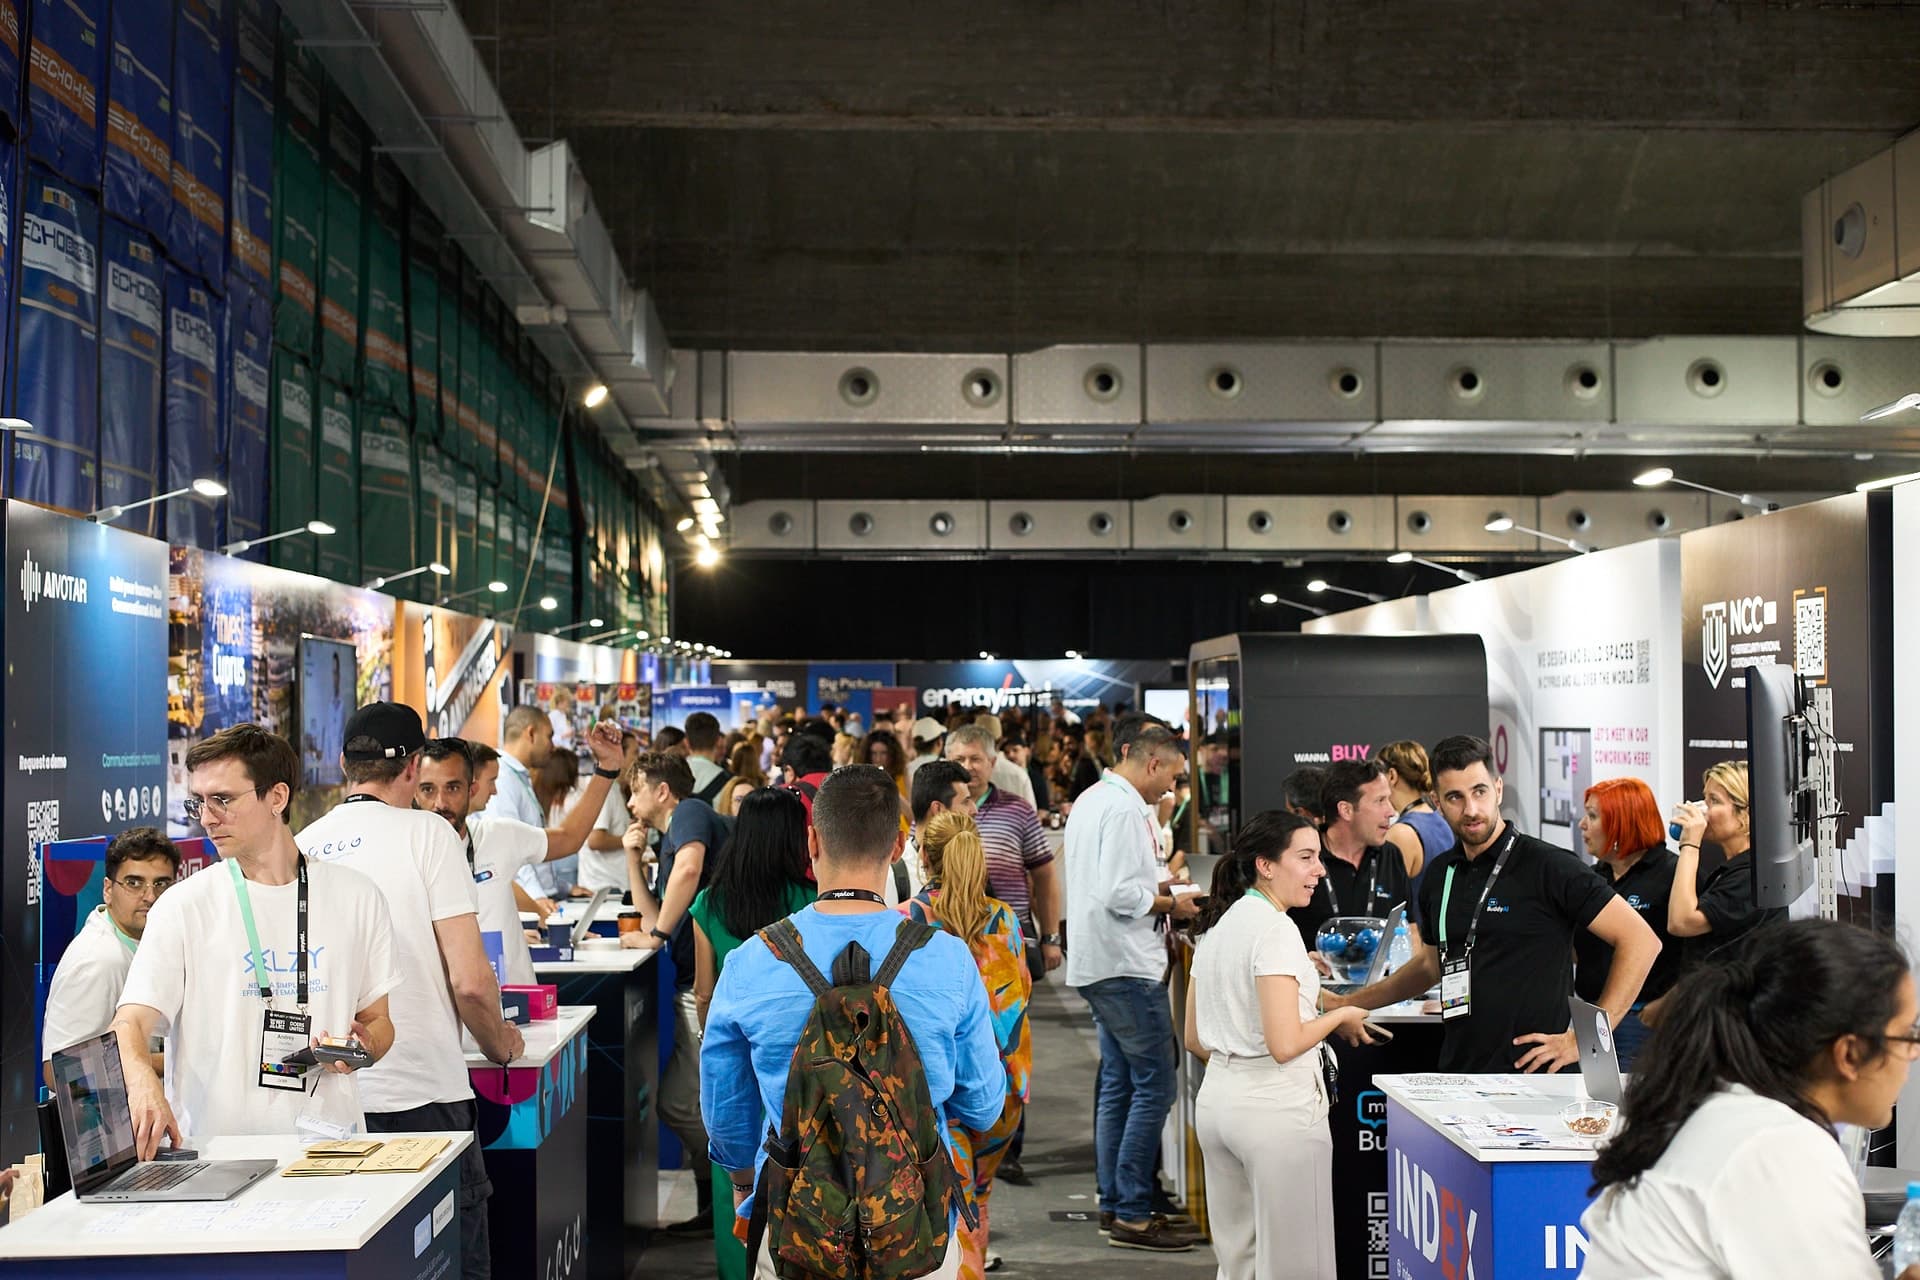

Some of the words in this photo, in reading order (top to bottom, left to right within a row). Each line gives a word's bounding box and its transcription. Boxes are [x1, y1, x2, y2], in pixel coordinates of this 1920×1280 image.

[43, 571, 87, 603] AIVOTAR
[1730, 595, 1763, 636] NCC
[1605, 642, 1633, 661] SPACES
[213, 643, 245, 696] Cyprus
[1612, 669, 1633, 685] WORLD
[1611, 727, 1625, 741] MEET
[1635, 727, 1648, 742] OUR
[1293, 752, 1330, 763] WANNA
[1331, 744, 1371, 762] BUY
[1595, 750, 1631, 765] COWORKING
[1395, 1147, 1478, 1280] INDEX
